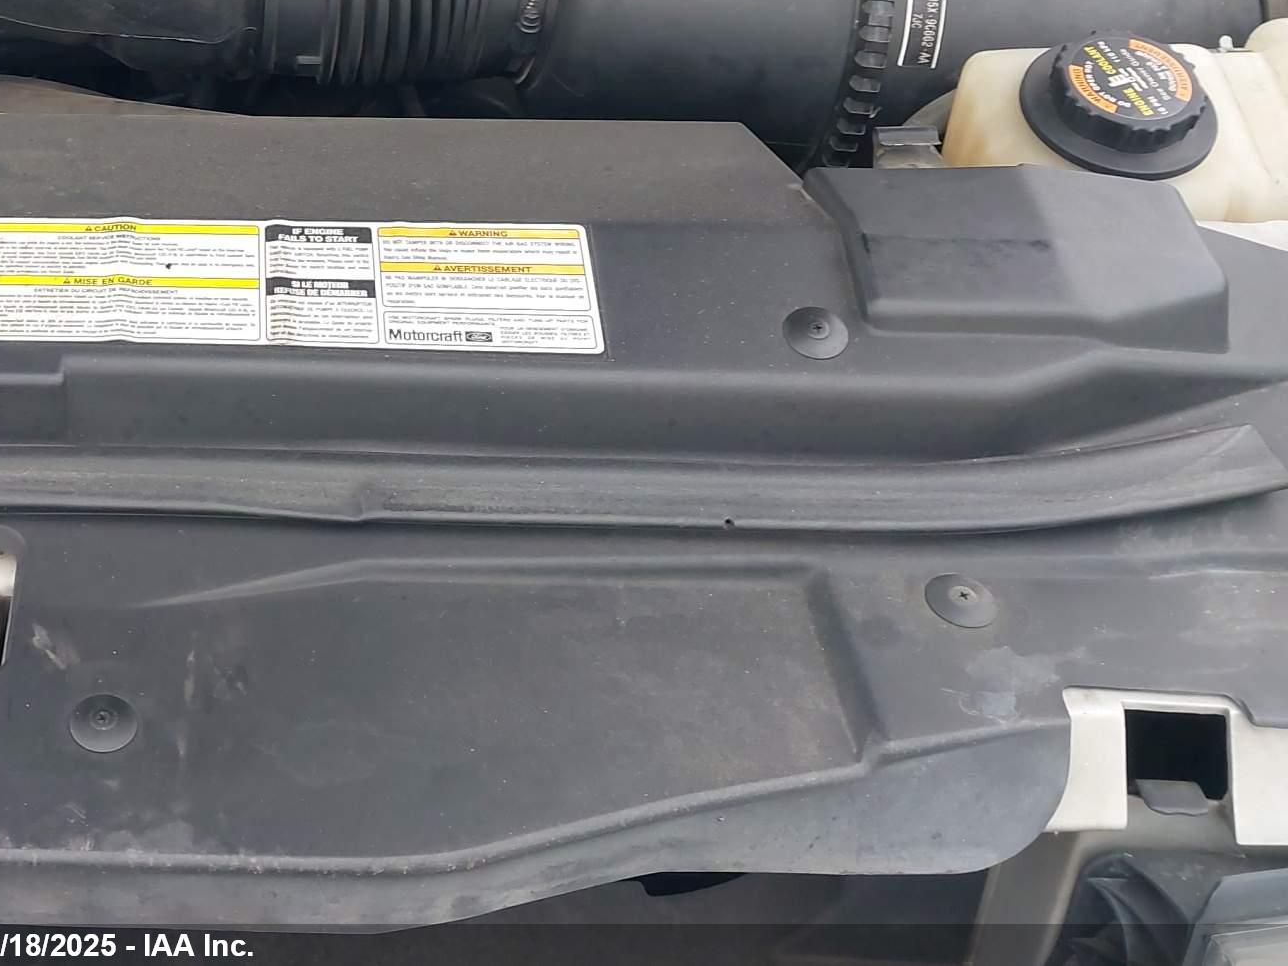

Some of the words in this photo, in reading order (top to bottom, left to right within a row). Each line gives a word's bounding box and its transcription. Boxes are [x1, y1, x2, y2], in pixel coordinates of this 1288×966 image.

[1083, 45, 1118, 76] COOLANT
[1071, 67, 1103, 103] WARNING
[1121, 87, 1155, 117] ENGINE
[94, 223, 137, 232] CAUTION
[292, 227, 303, 235] IF
[304, 228, 345, 236] ENGINE
[458, 229, 509, 238] WARNING
[278, 234, 308, 243] FAILS
[308, 235, 321, 243] TO
[443, 265, 533, 274] AVERTISSEMENT
[73, 277, 99, 285] MISE
[101, 277, 115, 285] EN
[117, 276, 153, 286] GARDE
[388, 328, 464, 343] Motorcraft
